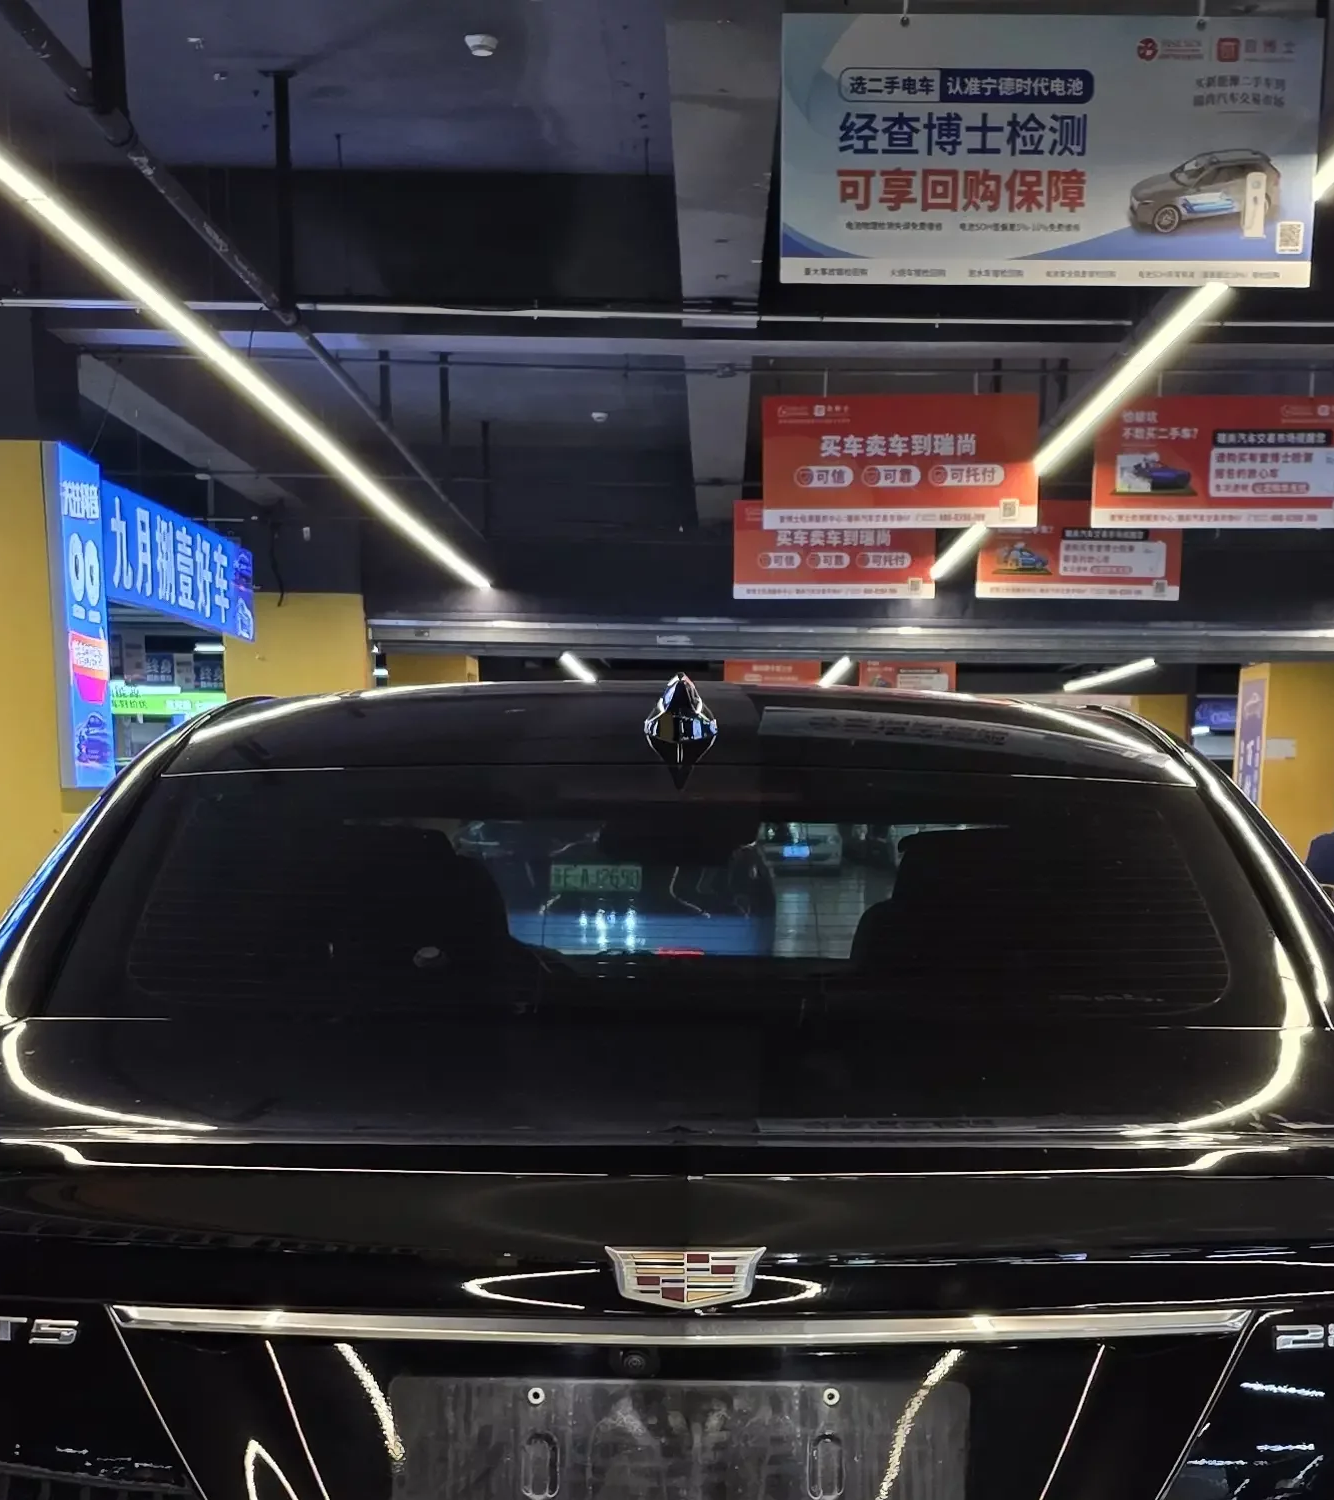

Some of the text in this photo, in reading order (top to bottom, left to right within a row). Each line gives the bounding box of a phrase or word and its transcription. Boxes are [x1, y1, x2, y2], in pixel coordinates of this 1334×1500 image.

[849, 76, 1084, 96] 选二手电车 认准宁德时代电池
[838, 113, 1087, 157] 经查博士检测
[836, 169, 1087, 213] 可享回购保障
[820, 433, 976, 457] 买车卖车到瑞尚
[816, 467, 996, 484] 可信 可靠 可托付
[776, 530, 891, 547] 买车卖车到瑞尚
[111, 497, 230, 623] 九月捌壹好车
